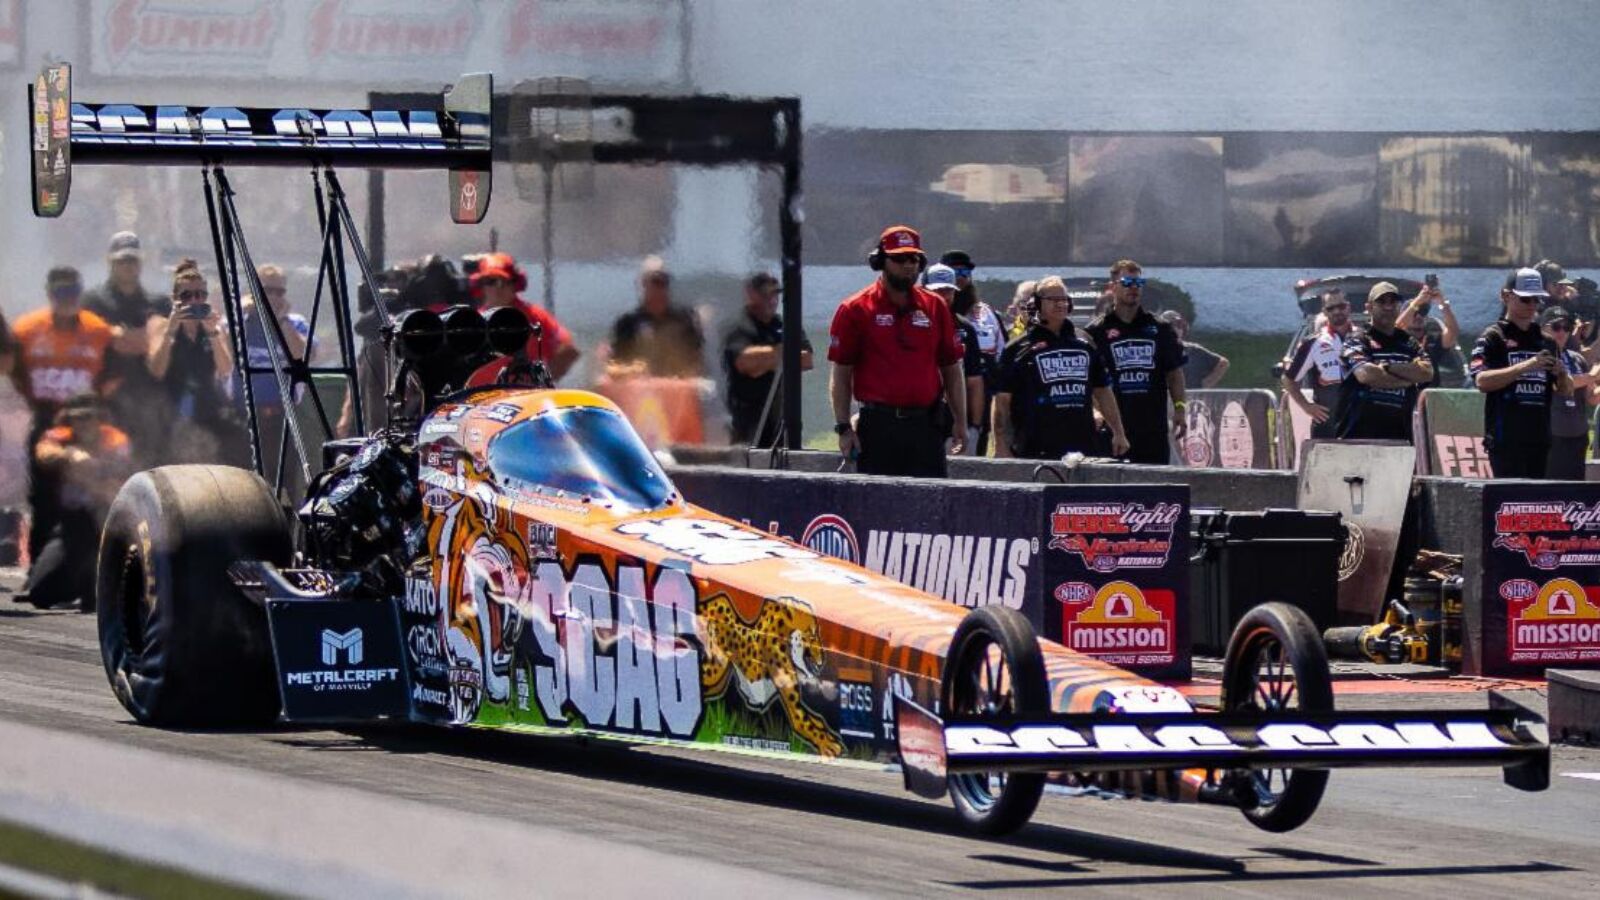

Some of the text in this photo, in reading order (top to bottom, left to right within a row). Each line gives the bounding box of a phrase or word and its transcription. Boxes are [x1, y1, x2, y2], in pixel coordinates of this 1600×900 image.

[1118, 371, 1150, 383] ALLOY
[1050, 383, 1087, 397] ALLOY
[1058, 505, 1122, 516] AMERICAN
[1502, 504, 1563, 514] AMERICAN
[1053, 515, 1129, 533] REBEL
[1498, 512, 1571, 532] REBEL
[1526, 534, 1600, 559] Virgini
[1117, 556, 1165, 566] NATIONALS
[1560, 553, 1600, 563] NATIONAL
[1060, 588, 1091, 600] NHRA
[1505, 583, 1534, 598] NHRA
[1073, 627, 1165, 648] MISSION
[532, 561, 703, 736] SCAG
[1136, 655, 1174, 665] SERIES
[1540, 651, 1578, 661] RACING
[286, 668, 400, 686] METALCRAFT
[313, 682, 372, 692] OF MAYVILLE
